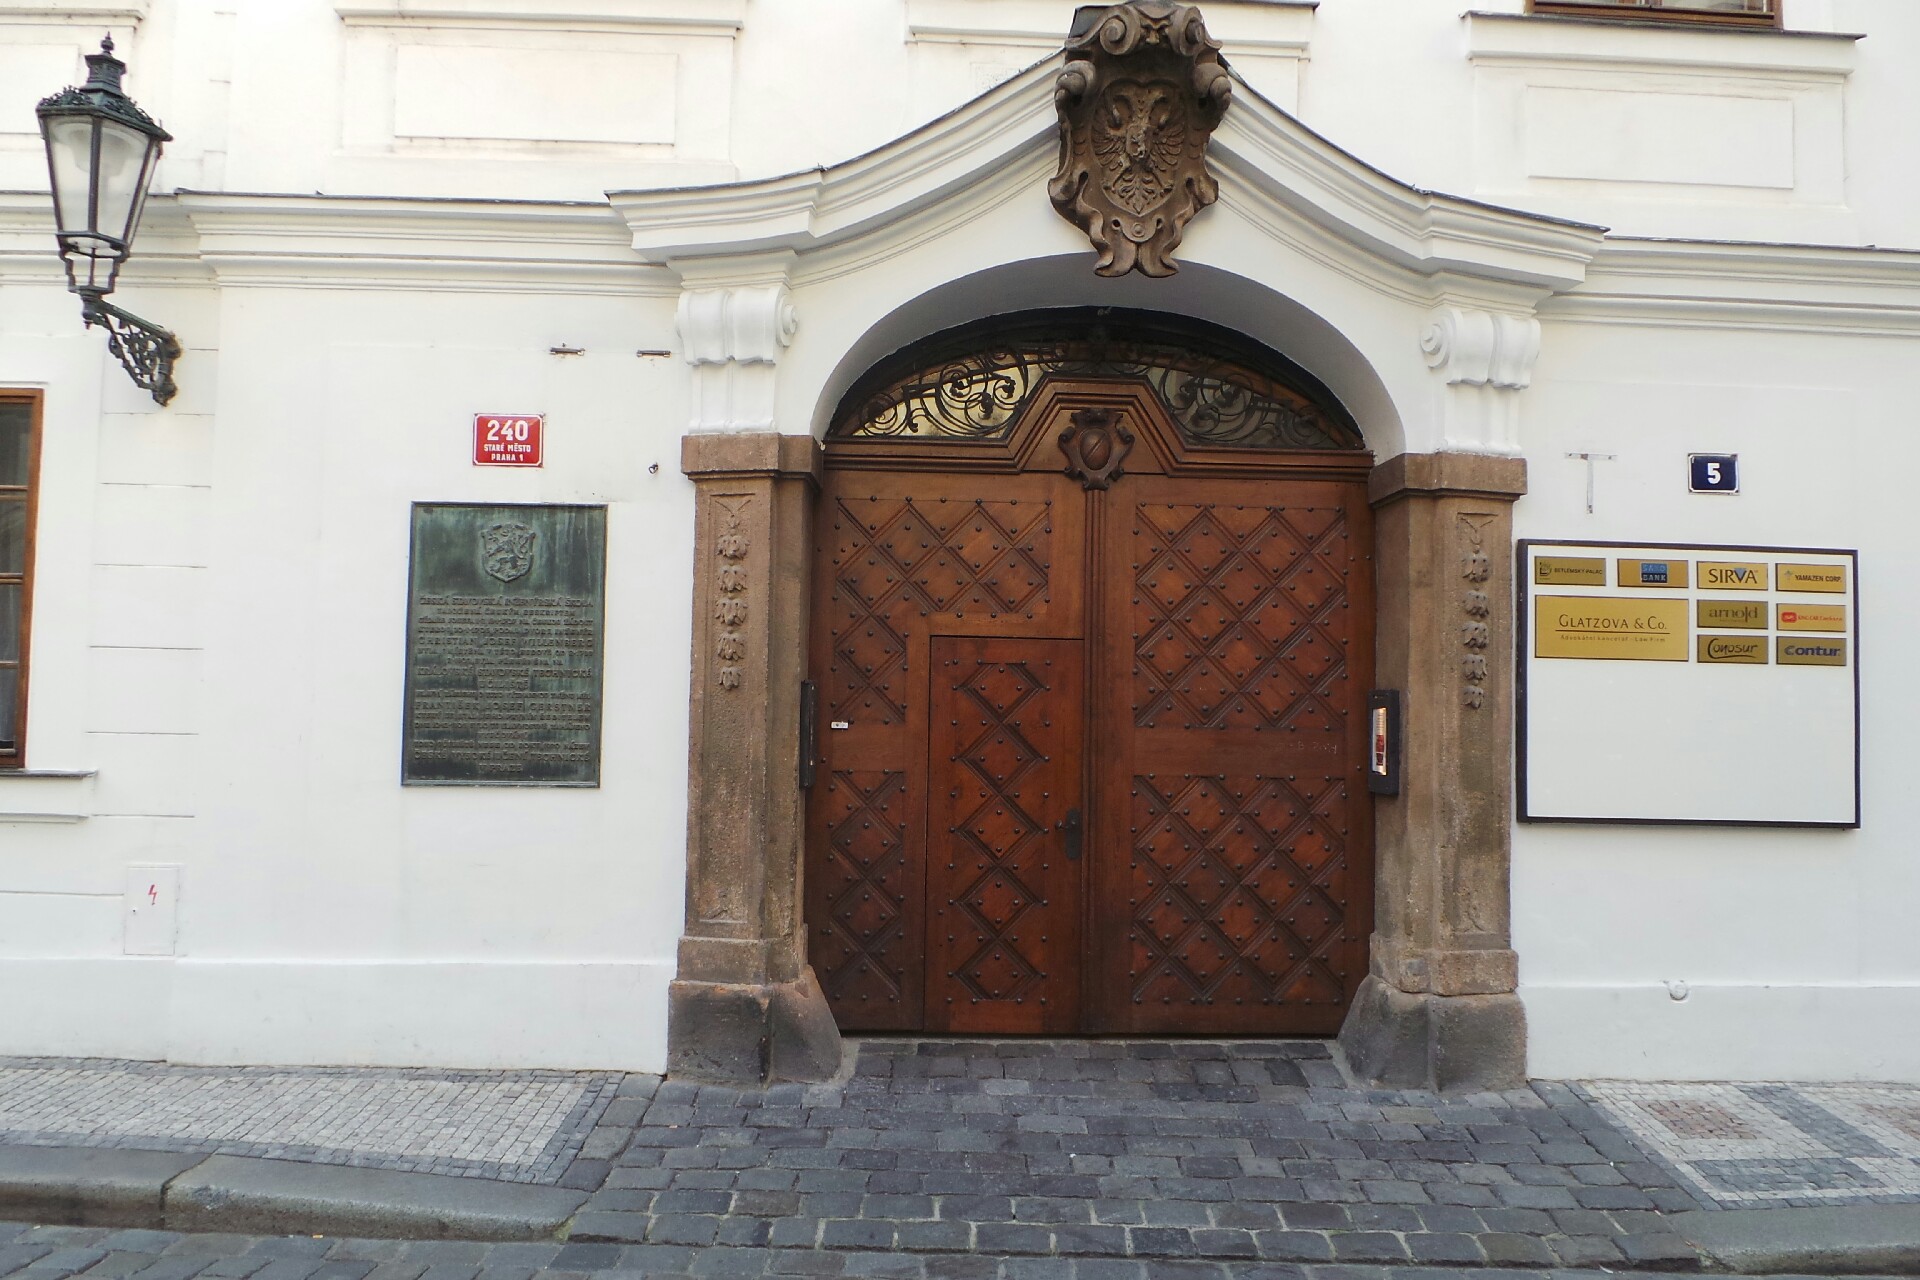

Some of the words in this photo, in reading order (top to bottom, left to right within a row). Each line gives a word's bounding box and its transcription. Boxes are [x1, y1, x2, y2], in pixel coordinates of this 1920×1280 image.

[487, 419, 529, 441] 240
[483, 443, 505, 452] STARÉ
[507, 442, 531, 453] MĚSTO
[491, 453, 516, 461] PRAHA
[518, 453, 524, 462] 1
[1707, 462, 1721, 485] 5
[1642, 574, 1667, 582] BANK
[1708, 567, 1758, 585] SIRVA
[1794, 574, 1824, 582] YAMAZEN
[1708, 606, 1758, 623] arnold
[1559, 614, 1629, 630] GLATZOVA
[1633, 617, 1645, 630] &
[1784, 645, 1841, 657] Contur
